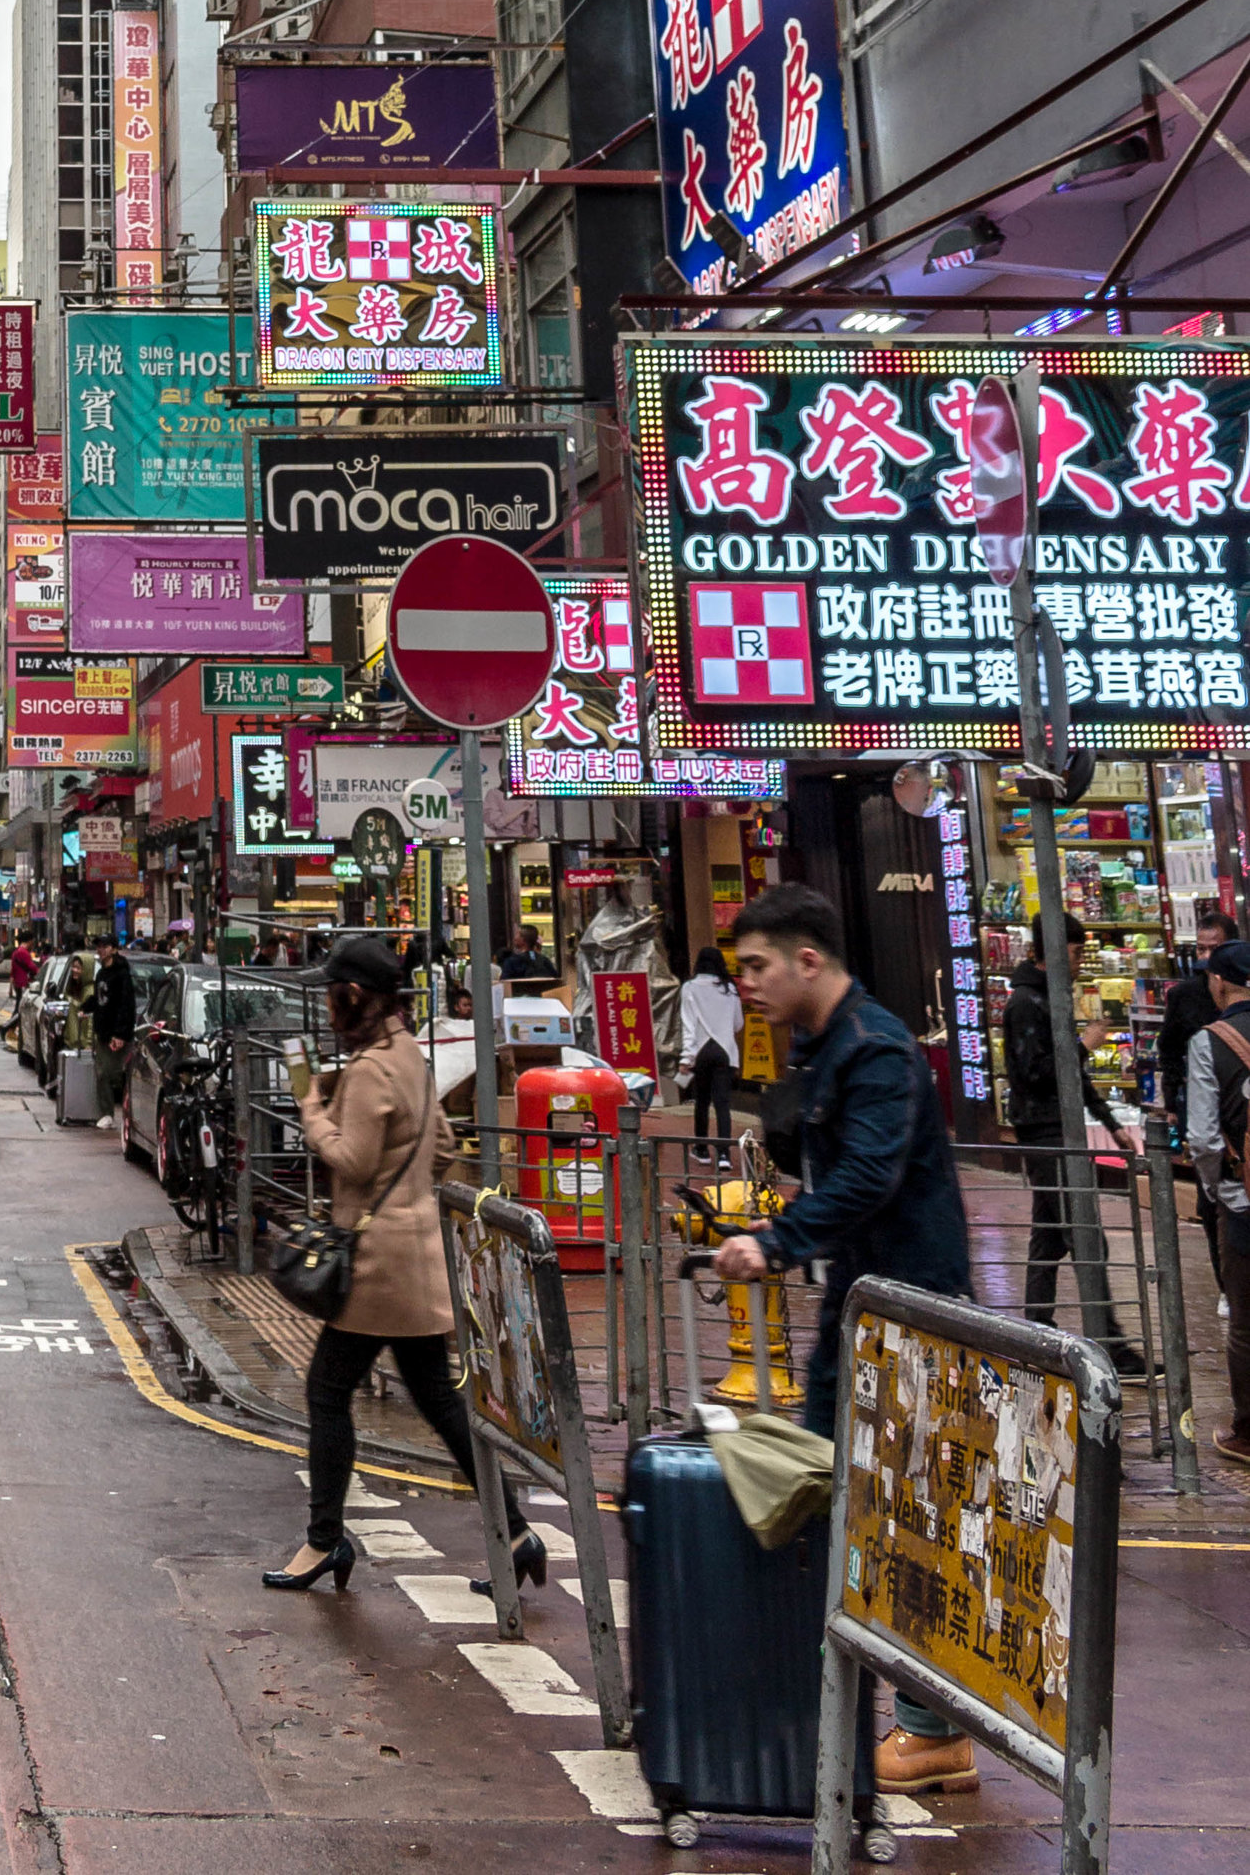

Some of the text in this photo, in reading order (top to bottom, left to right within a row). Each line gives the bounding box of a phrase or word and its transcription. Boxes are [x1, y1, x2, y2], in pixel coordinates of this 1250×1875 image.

[125, 25, 152, 141] 瓊華中心
[679, 17, 824, 252] 大藥房
[126, 151, 153, 251] 層層美食
[271, 217, 484, 285] 龍 城
[283, 284, 477, 346] 大藥房
[4, 311, 23, 390] 時租過夜
[139, 346, 174, 360] SING
[274, 347, 488, 371] DRAGON CITY DISPENSARY
[139, 362, 174, 376] YUET
[179, 416, 222, 433] 2770
[80, 386, 117, 486] 賓館
[167, 472, 196, 482] YUEN
[198, 472, 223, 482] KING
[290, 489, 539, 532] moca hair
[14, 534, 47, 547] KING
[378, 545, 418, 557] We lov
[683, 533, 1229, 574] GOLDEN DISENSARY
[152, 560, 190, 569] HOURLY
[193, 560, 223, 569] HOTEL
[327, 563, 402, 577] appointmen
[817, 582, 1241, 642] 政府註冊 專營批發
[185, 621, 213, 631] YUEN
[215, 621, 238, 631] KING
[240, 621, 287, 633] BUILDING
[824, 648, 1023, 708] 老牌正藥
[20, 698, 124, 716] sincere 先施
[38, 751, 134, 763] TEL: 2377-2263
[526, 748, 643, 782] 政府註冊
[351, 794, 388, 803] OPTICAL
[409, 794, 448, 819] 5M
[366, 816, 387, 831] 5M
[604, 980, 614, 998] HUI
[606, 1000, 617, 1019] LAU
